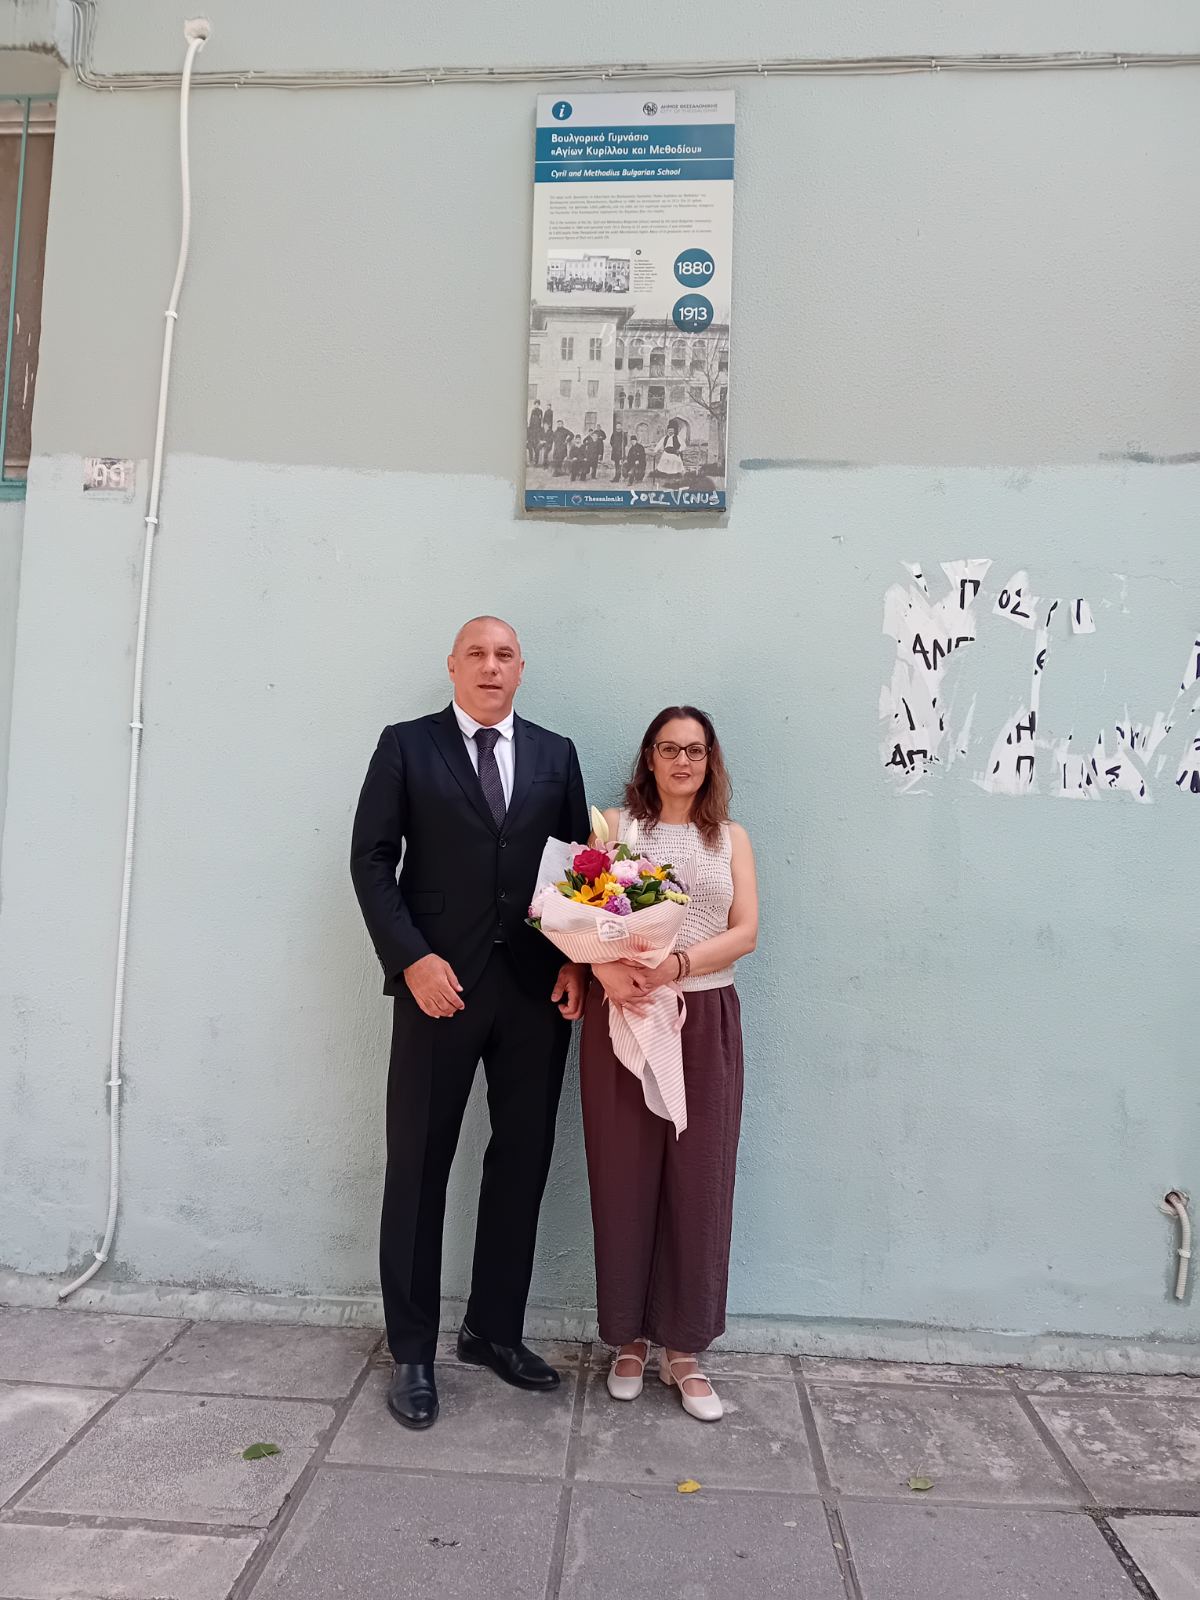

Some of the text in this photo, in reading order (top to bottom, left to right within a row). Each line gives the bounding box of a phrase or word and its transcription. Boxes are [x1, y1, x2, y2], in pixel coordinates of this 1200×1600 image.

[551, 132, 649, 144] Βουλγαρικό Γυμνάσιο
[551, 145, 702, 158] «Αγίων Κυρίλλου και Μεθοδίου»
[551, 167, 681, 179] Cyril and Methodius Bulgarian School
[677, 261, 713, 275] 1880
[679, 307, 708, 321] 1913
